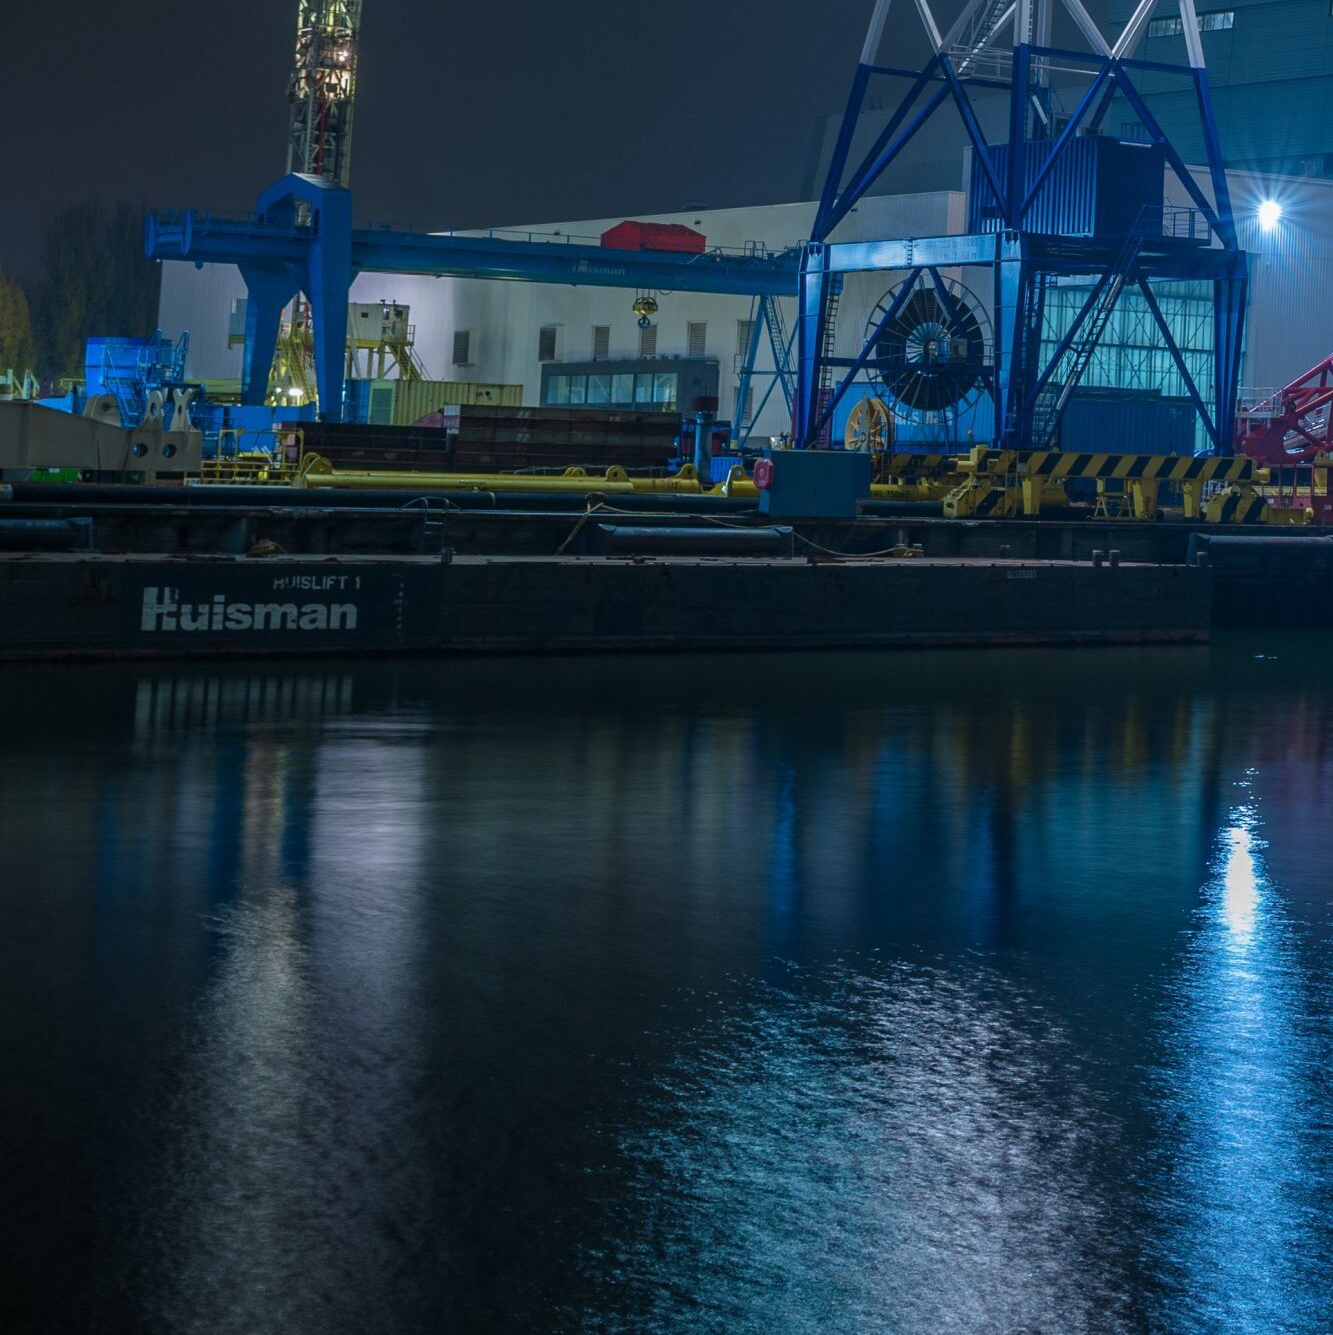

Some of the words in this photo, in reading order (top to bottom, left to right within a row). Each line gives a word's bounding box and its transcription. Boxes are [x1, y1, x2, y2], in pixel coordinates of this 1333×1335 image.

[272, 576, 349, 591] HUISLIFT
[353, 576, 361, 591] 1
[141, 586, 358, 632] Huisman
